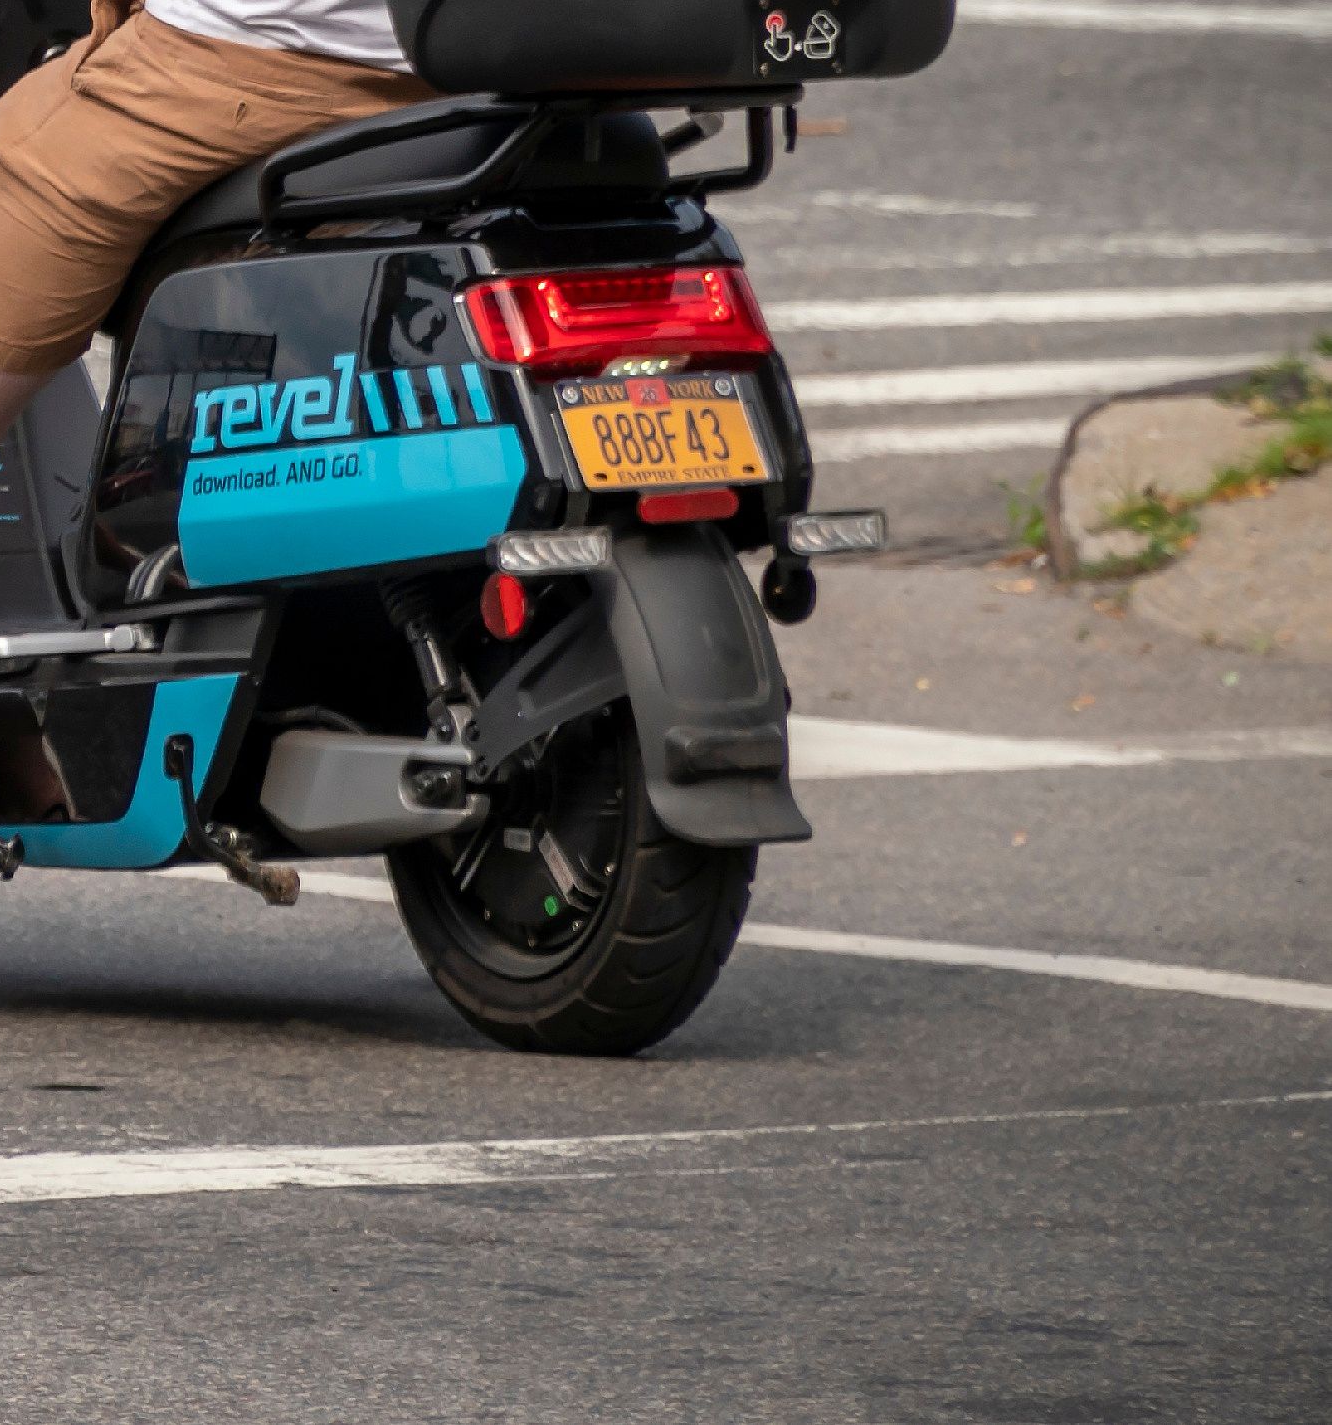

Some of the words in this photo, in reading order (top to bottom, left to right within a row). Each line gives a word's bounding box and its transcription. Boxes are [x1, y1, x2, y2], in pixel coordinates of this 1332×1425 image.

[190, 352, 357, 454] revel
[581, 384, 625, 404] NEW
[667, 379, 716, 399] YORK
[592, 407, 730, 467] 88BF43
[192, 464, 280, 496] download.
[286, 457, 325, 486] AND
[331, 452, 363, 478] GO.
[616, 470, 677, 484] EMPIRE
[682, 466, 730, 480] STATE
